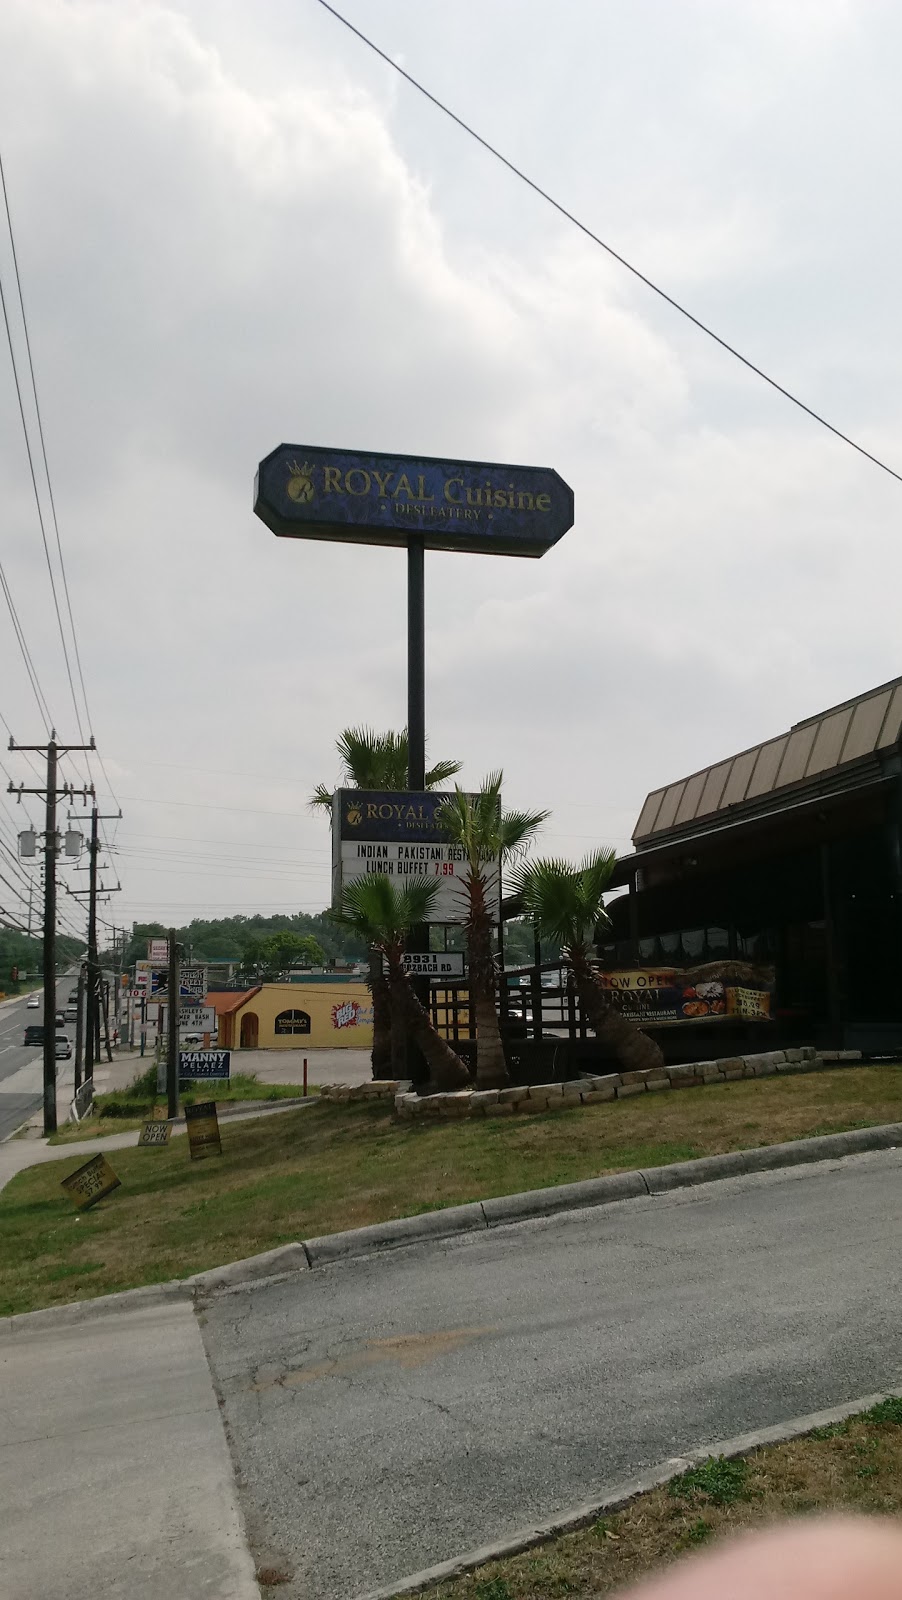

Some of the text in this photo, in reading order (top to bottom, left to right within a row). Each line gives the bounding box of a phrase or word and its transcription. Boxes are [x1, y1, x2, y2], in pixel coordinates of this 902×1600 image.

[323, 466, 552, 512] ROYAL Cuisine
[394, 502, 482, 521] DESI EATERY
[366, 803, 429, 821] ROYAL
[357, 844, 388, 858] INDIAN
[398, 846, 444, 860] PAKISTANI
[366, 861, 454, 876] LUNCH BUFFET 7.99
[441, 963, 452, 972] RD
[600, 975, 676, 988] NOW OPEN
[336, 1003, 353, 1019] BIG
[338, 1008, 356, 1027] RED
[180, 1052, 227, 1062] MANNY
[182, 1061, 224, 1069] PELAEZ
[145, 1125, 168, 1133] NOW
[142, 1133, 168, 1141] OPEN
